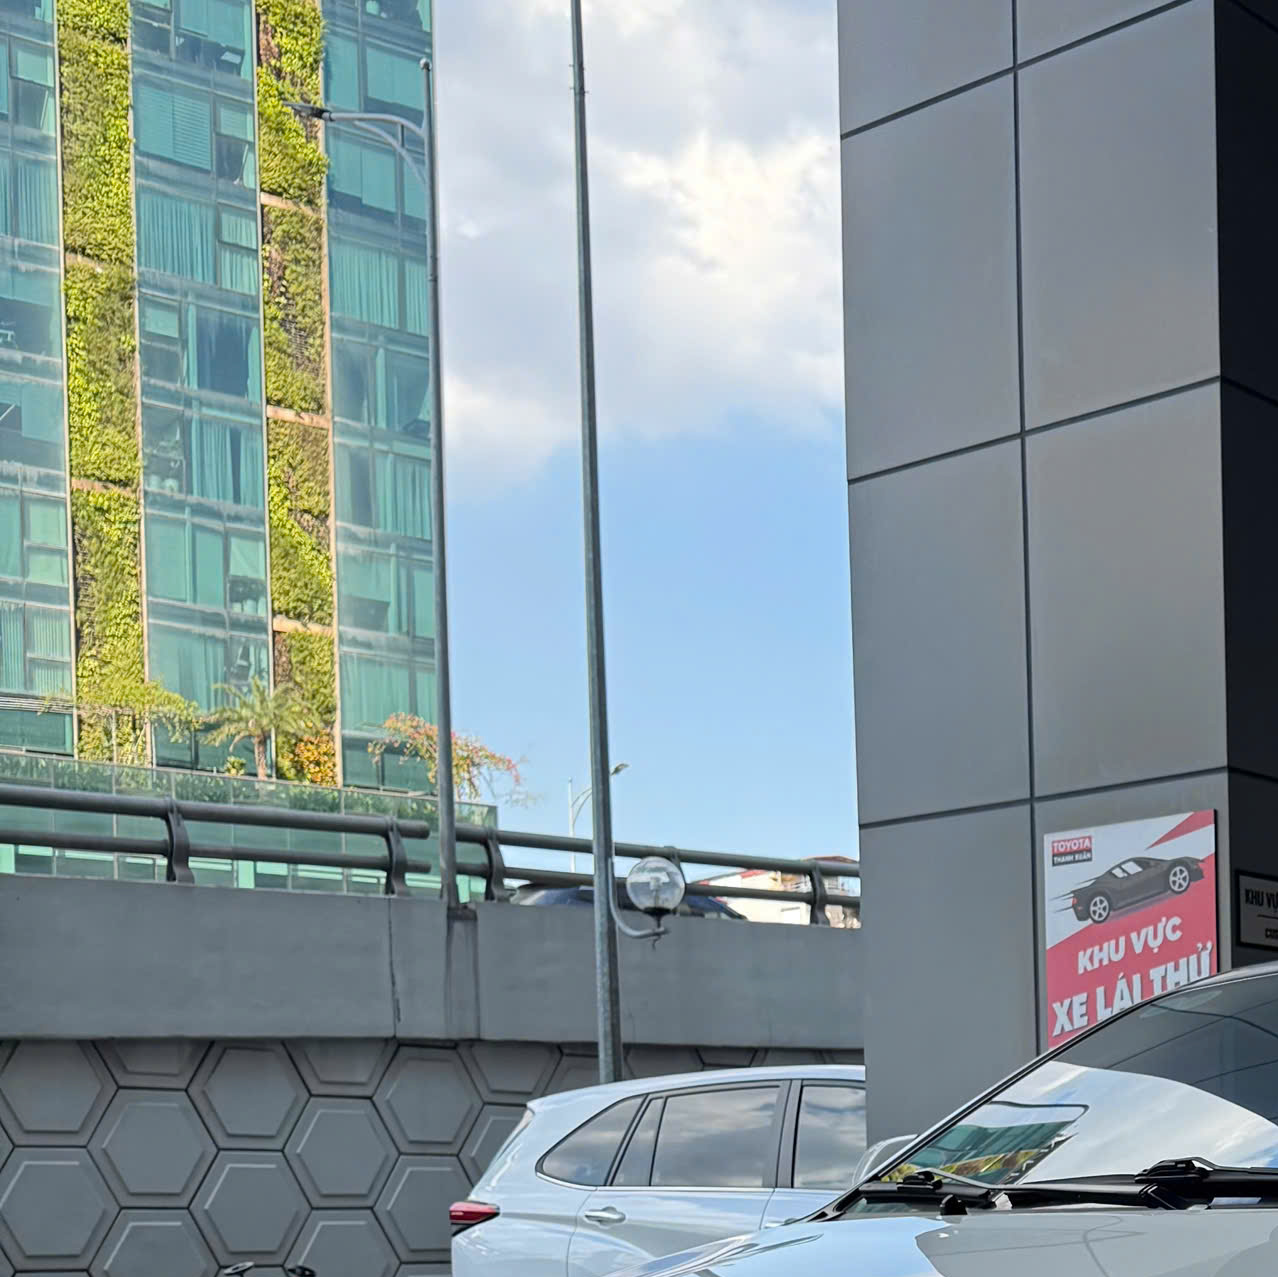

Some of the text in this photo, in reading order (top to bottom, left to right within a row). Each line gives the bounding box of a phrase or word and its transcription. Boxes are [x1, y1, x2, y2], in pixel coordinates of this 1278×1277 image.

[1052, 838, 1091, 853] TOYOTA
[1244, 888, 1265, 907] KHU
[1077, 915, 1183, 975] KHU VỰC
[1052, 940, 1212, 1037] XE LÁI THỬ
